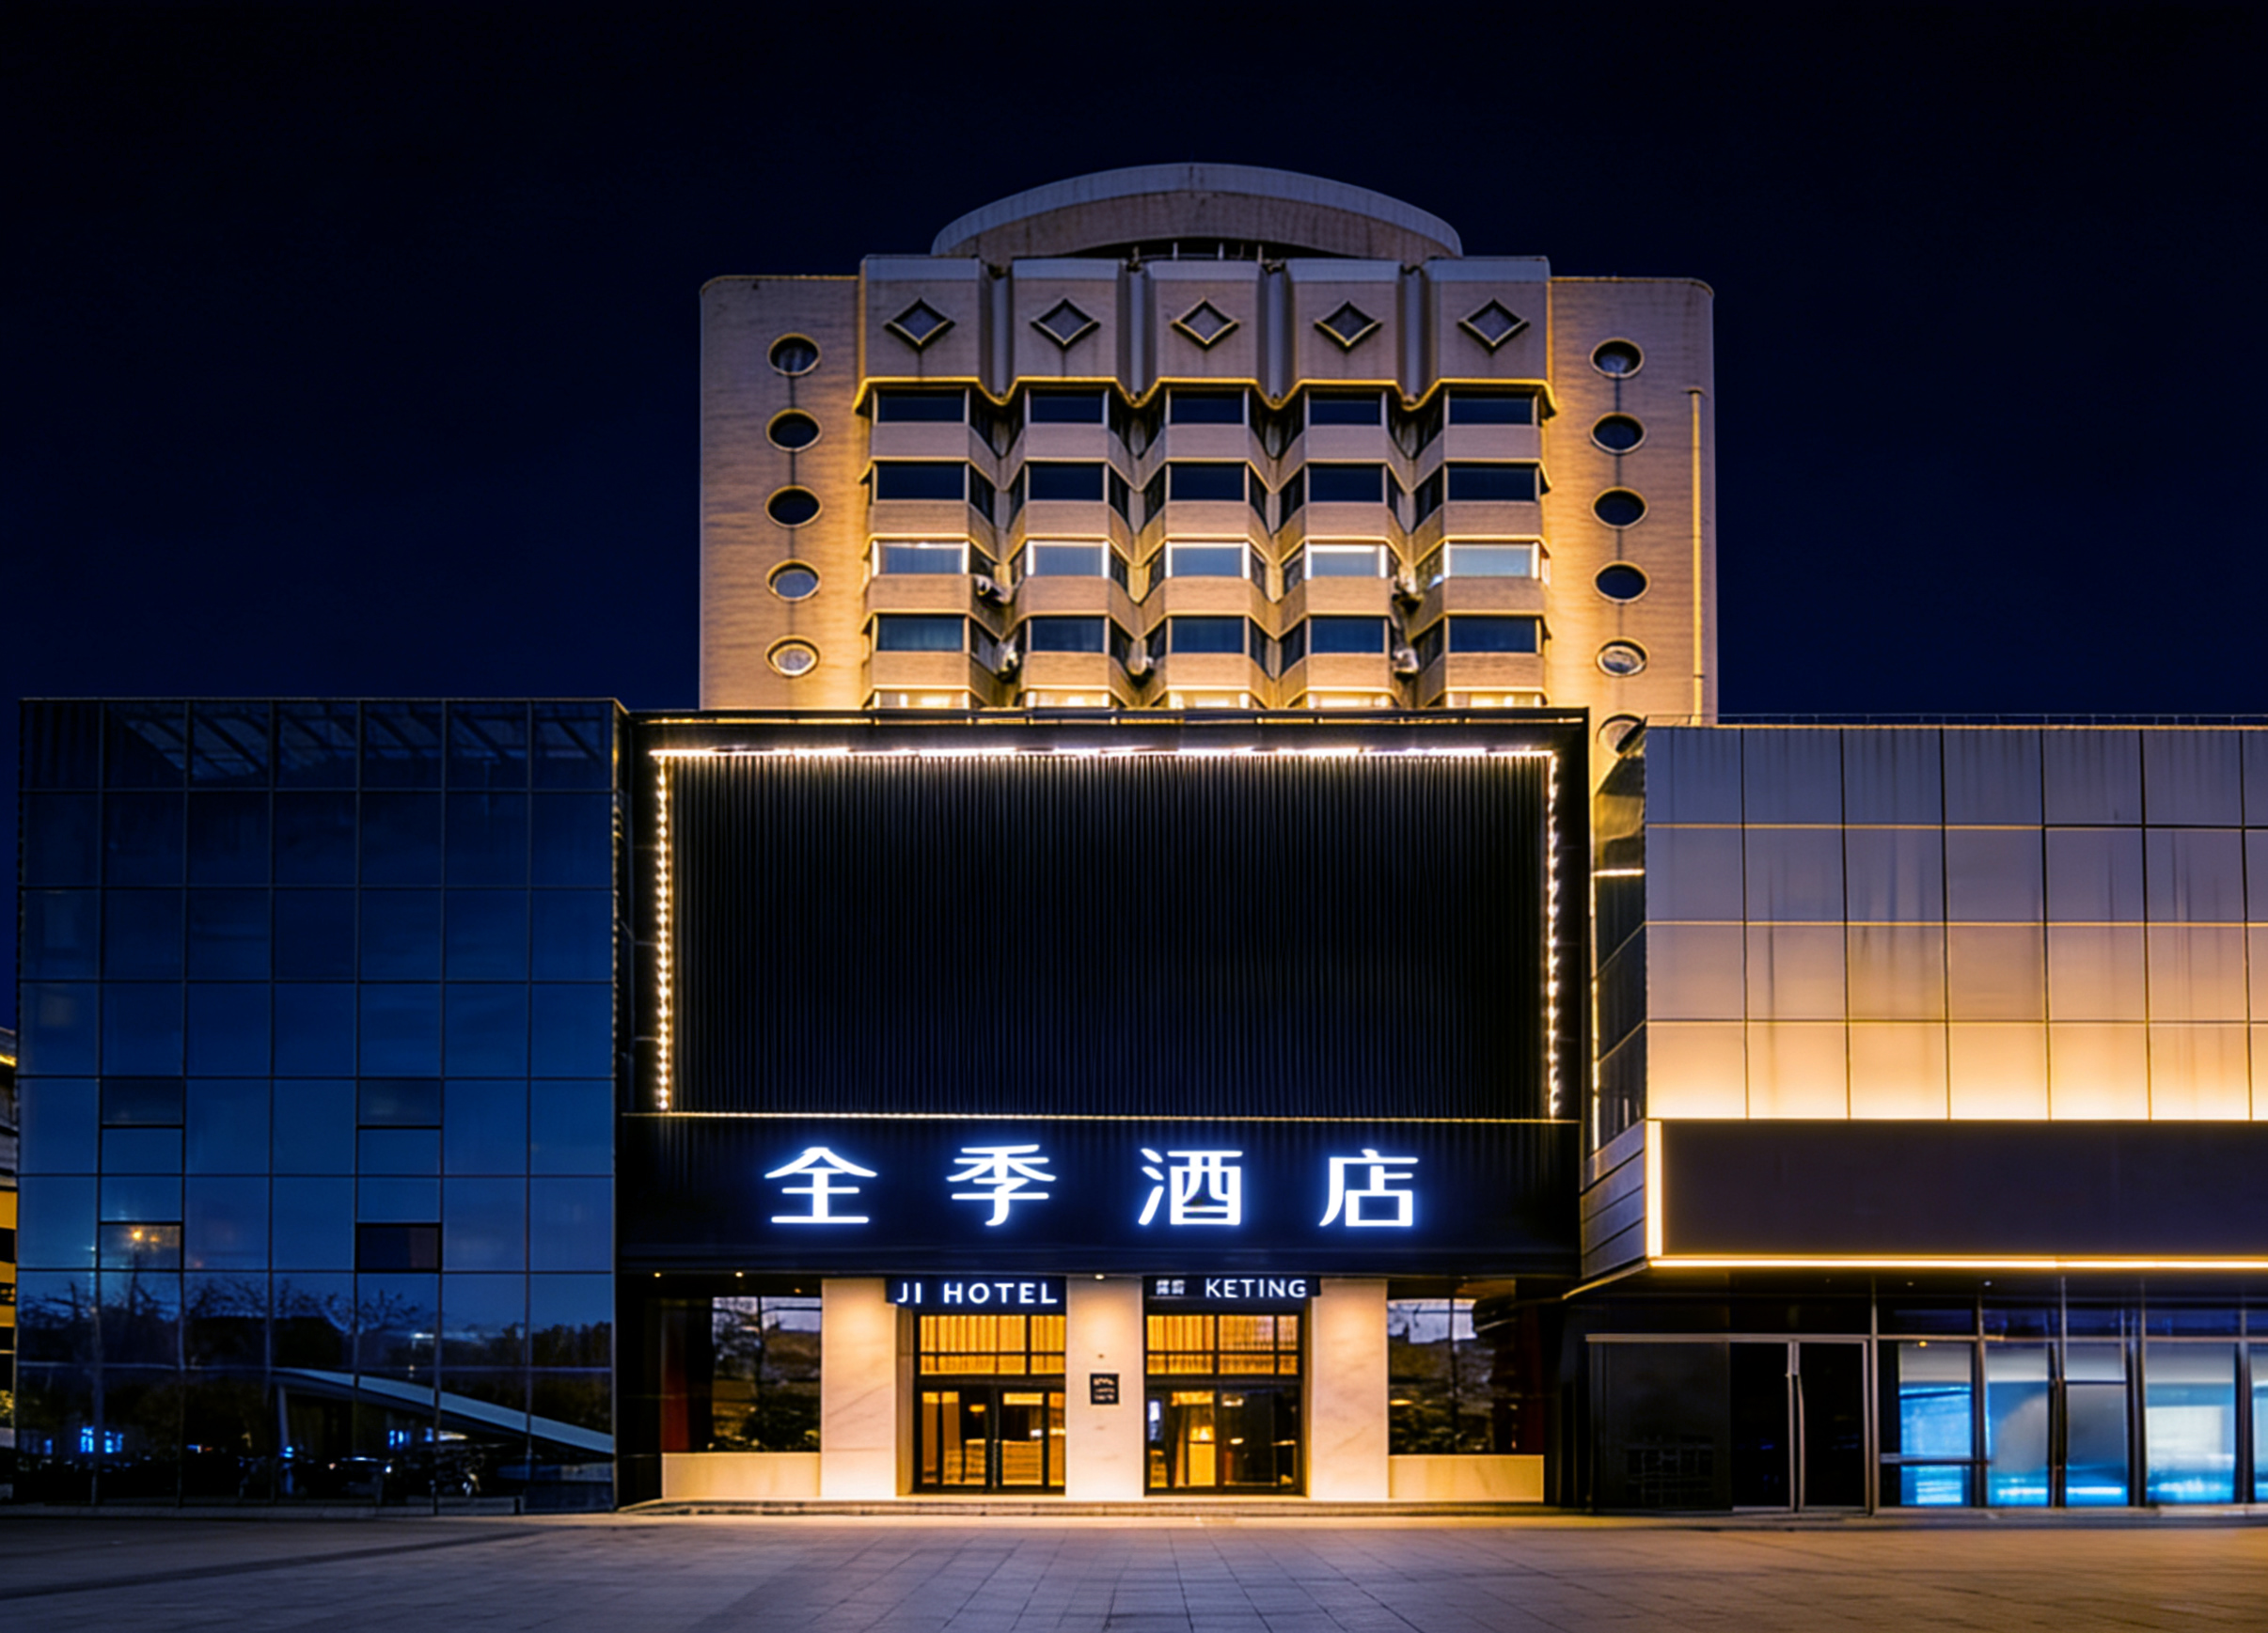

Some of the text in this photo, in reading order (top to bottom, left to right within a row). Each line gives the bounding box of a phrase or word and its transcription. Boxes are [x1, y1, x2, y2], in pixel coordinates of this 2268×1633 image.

[764, 1144, 1418, 1227] 全季酒店
[896, 1282, 1058, 1305] JI HOTEL
[1205, 1278, 1307, 1298] KETING
